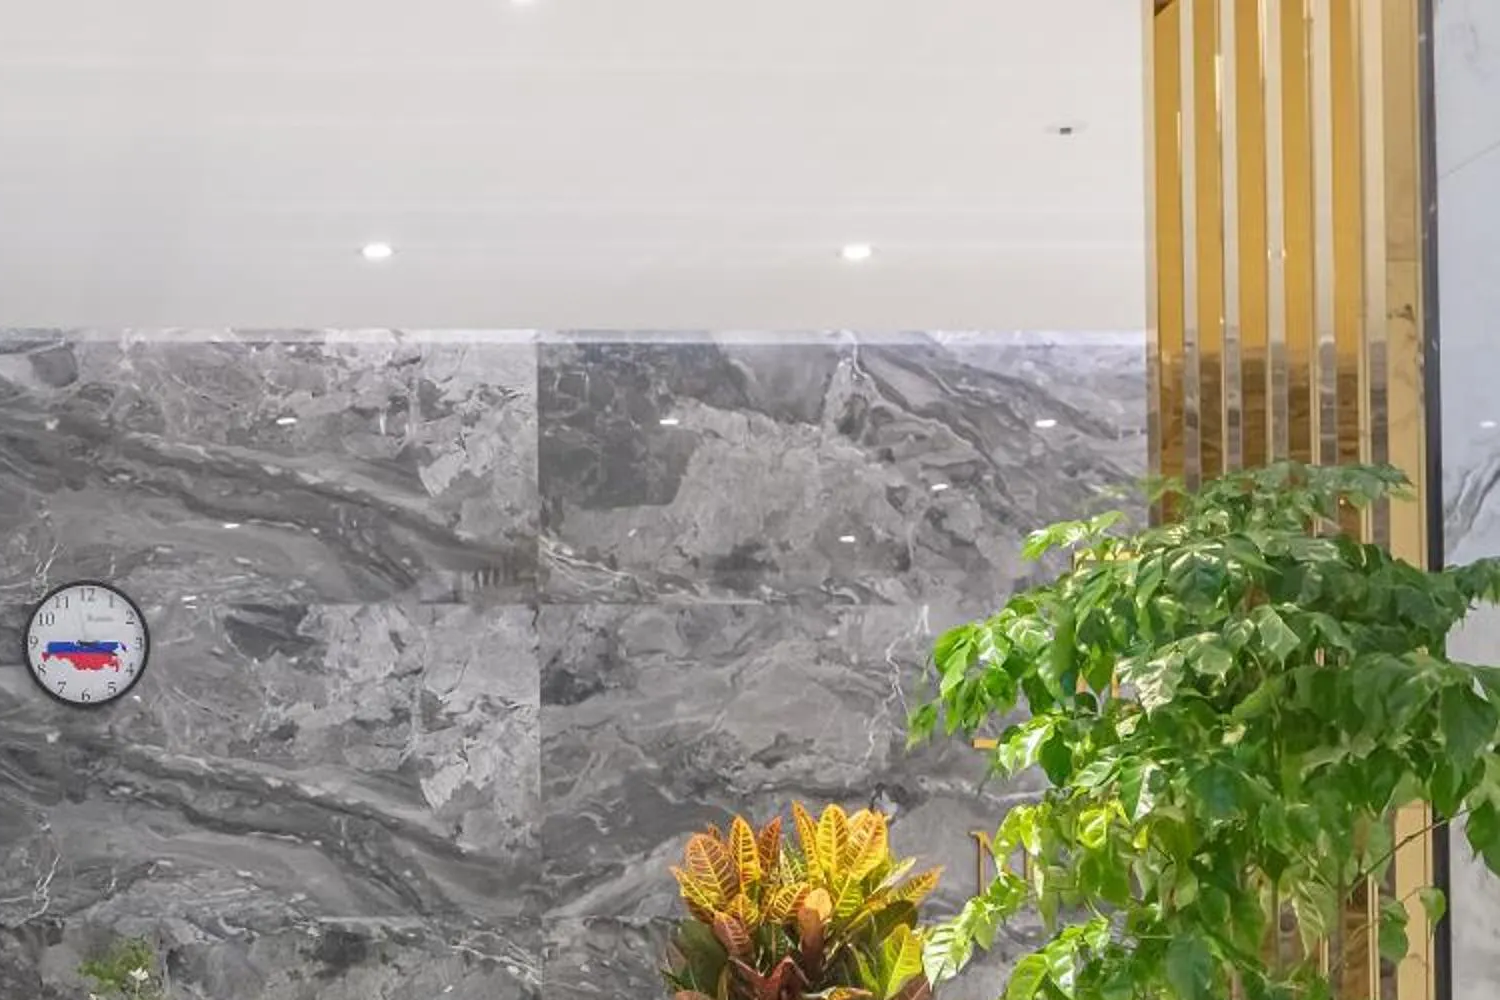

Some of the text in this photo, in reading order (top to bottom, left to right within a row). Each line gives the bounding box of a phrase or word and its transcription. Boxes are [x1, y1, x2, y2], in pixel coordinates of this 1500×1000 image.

[81, 588, 95, 601] 12
[109, 594, 114, 608] 1
[55, 596, 69, 609] 11
[38, 611, 55, 626] 10
[125, 610, 135, 625] 2
[29, 635, 39, 649] 9
[135, 636, 143, 650] 3
[125, 662, 134, 677] 4
[57, 681, 66, 694] 7
[81, 687, 91, 701] 6
[108, 681, 116, 695] 5
